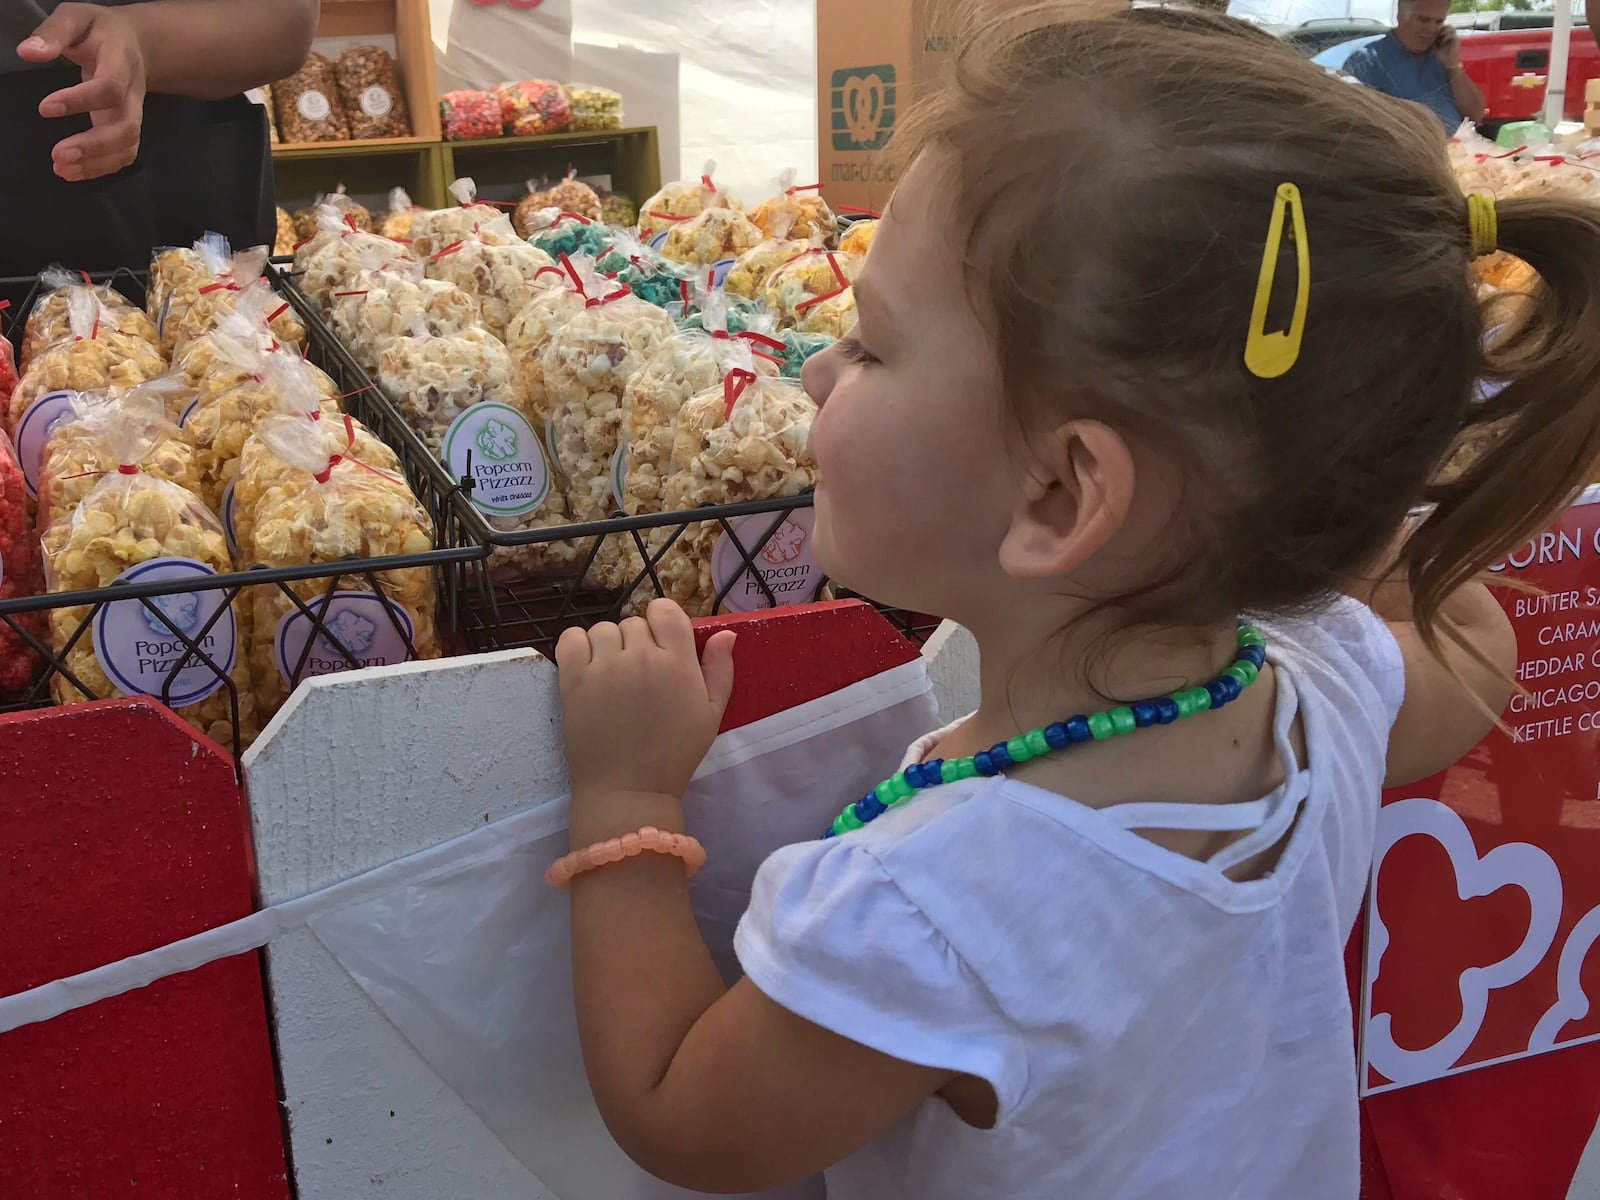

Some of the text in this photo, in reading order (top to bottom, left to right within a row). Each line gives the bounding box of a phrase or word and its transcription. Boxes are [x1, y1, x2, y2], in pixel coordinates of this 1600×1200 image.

[475, 462, 532, 477] Popcorn
[479, 475, 533, 491] Pizzazz
[1488, 528, 1582, 572] ORN
[745, 579, 805, 595] Pizazz
[1515, 586, 1600, 618] BUTTER S
[135, 635, 215, 657] Popcn
[309, 656, 386, 671] Popcorn
[1510, 681, 1600, 713] CHICAGO
[1513, 716, 1573, 744] KETTLE
